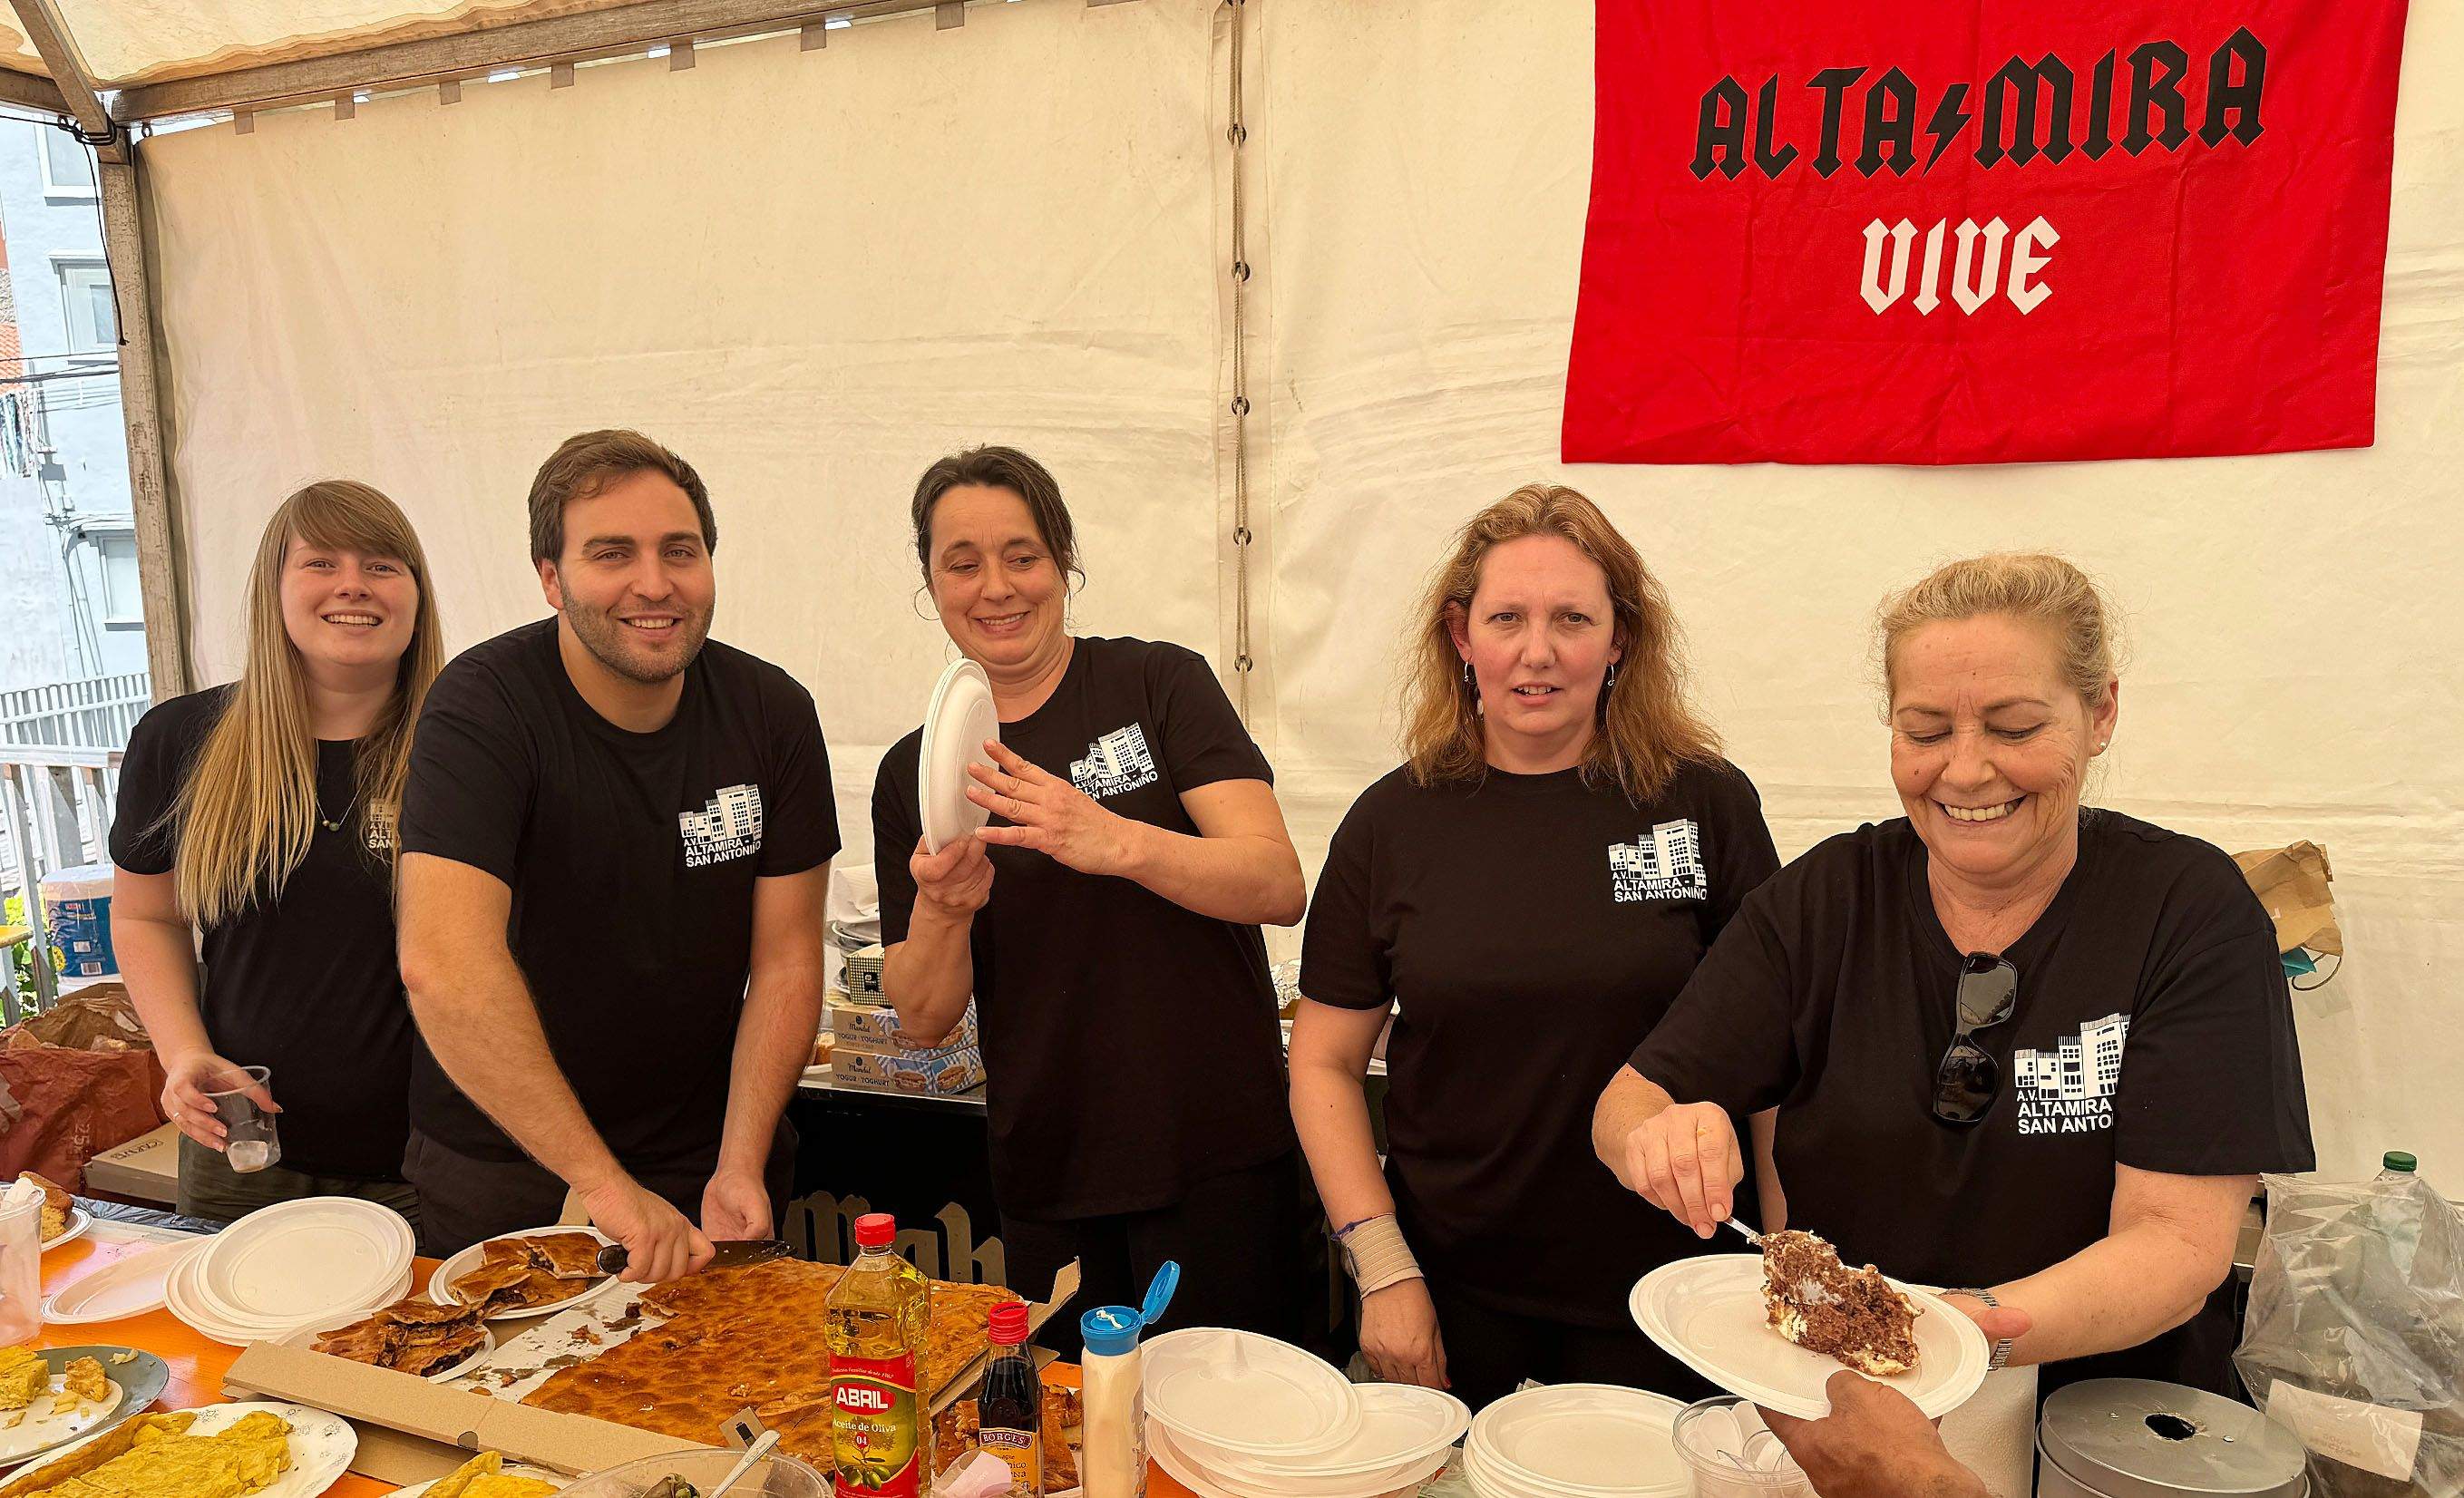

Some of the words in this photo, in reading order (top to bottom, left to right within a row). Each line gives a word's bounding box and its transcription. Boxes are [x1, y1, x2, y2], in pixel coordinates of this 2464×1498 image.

[1859, 215, 2061, 316] VIVE
[1084, 774, 1131, 794] LTAMIRA
[1103, 771, 1159, 797] ANTONIÑO
[685, 838, 744, 857] ALTAMIRA
[686, 855, 711, 868] SAN
[1613, 877, 1682, 891] ALTAMIRA
[1614, 890, 1642, 902] SAN
[1645, 885, 1708, 900] ANTONIÑO
[2016, 1089, 2038, 1102] A.V.
[2017, 1097, 2113, 1117] ALTAMIRA
[2018, 1117, 2057, 1134] SAN
[2060, 1114, 2114, 1133] ANTO
[835, 1386, 889, 1409] ABRIL
[833, 1418, 857, 1431] Aceite
[857, 1423, 870, 1432] de
[871, 1424, 897, 1433] Oliva
[983, 1433, 1025, 1444] BORGES
